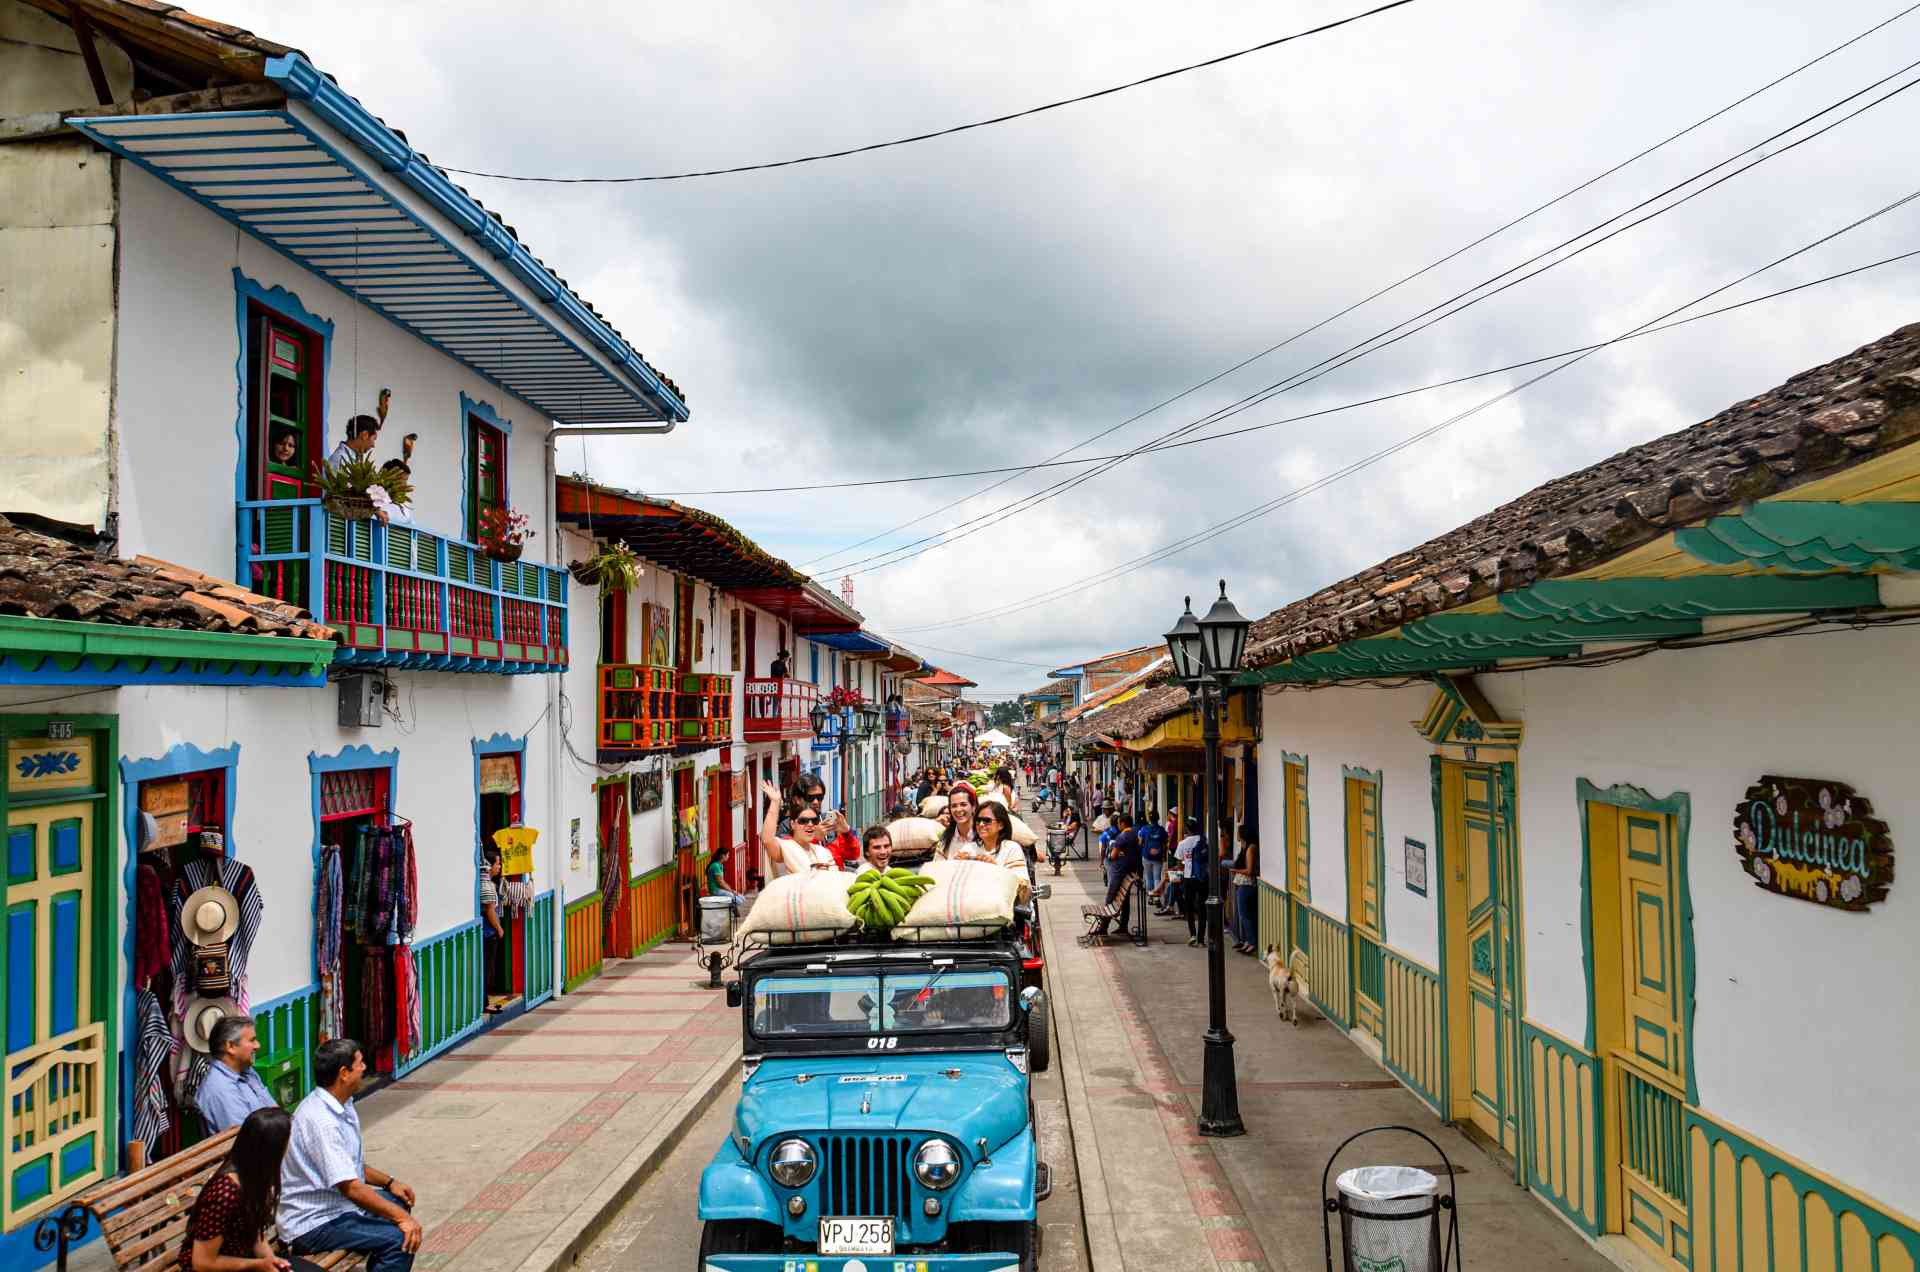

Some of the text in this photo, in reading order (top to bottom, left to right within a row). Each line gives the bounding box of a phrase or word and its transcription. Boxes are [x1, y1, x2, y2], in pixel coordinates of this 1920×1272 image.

[1750, 801, 1870, 878] Dulcinea
[867, 1037, 898, 1049] 018
[822, 1223, 891, 1244] VPJ 258
